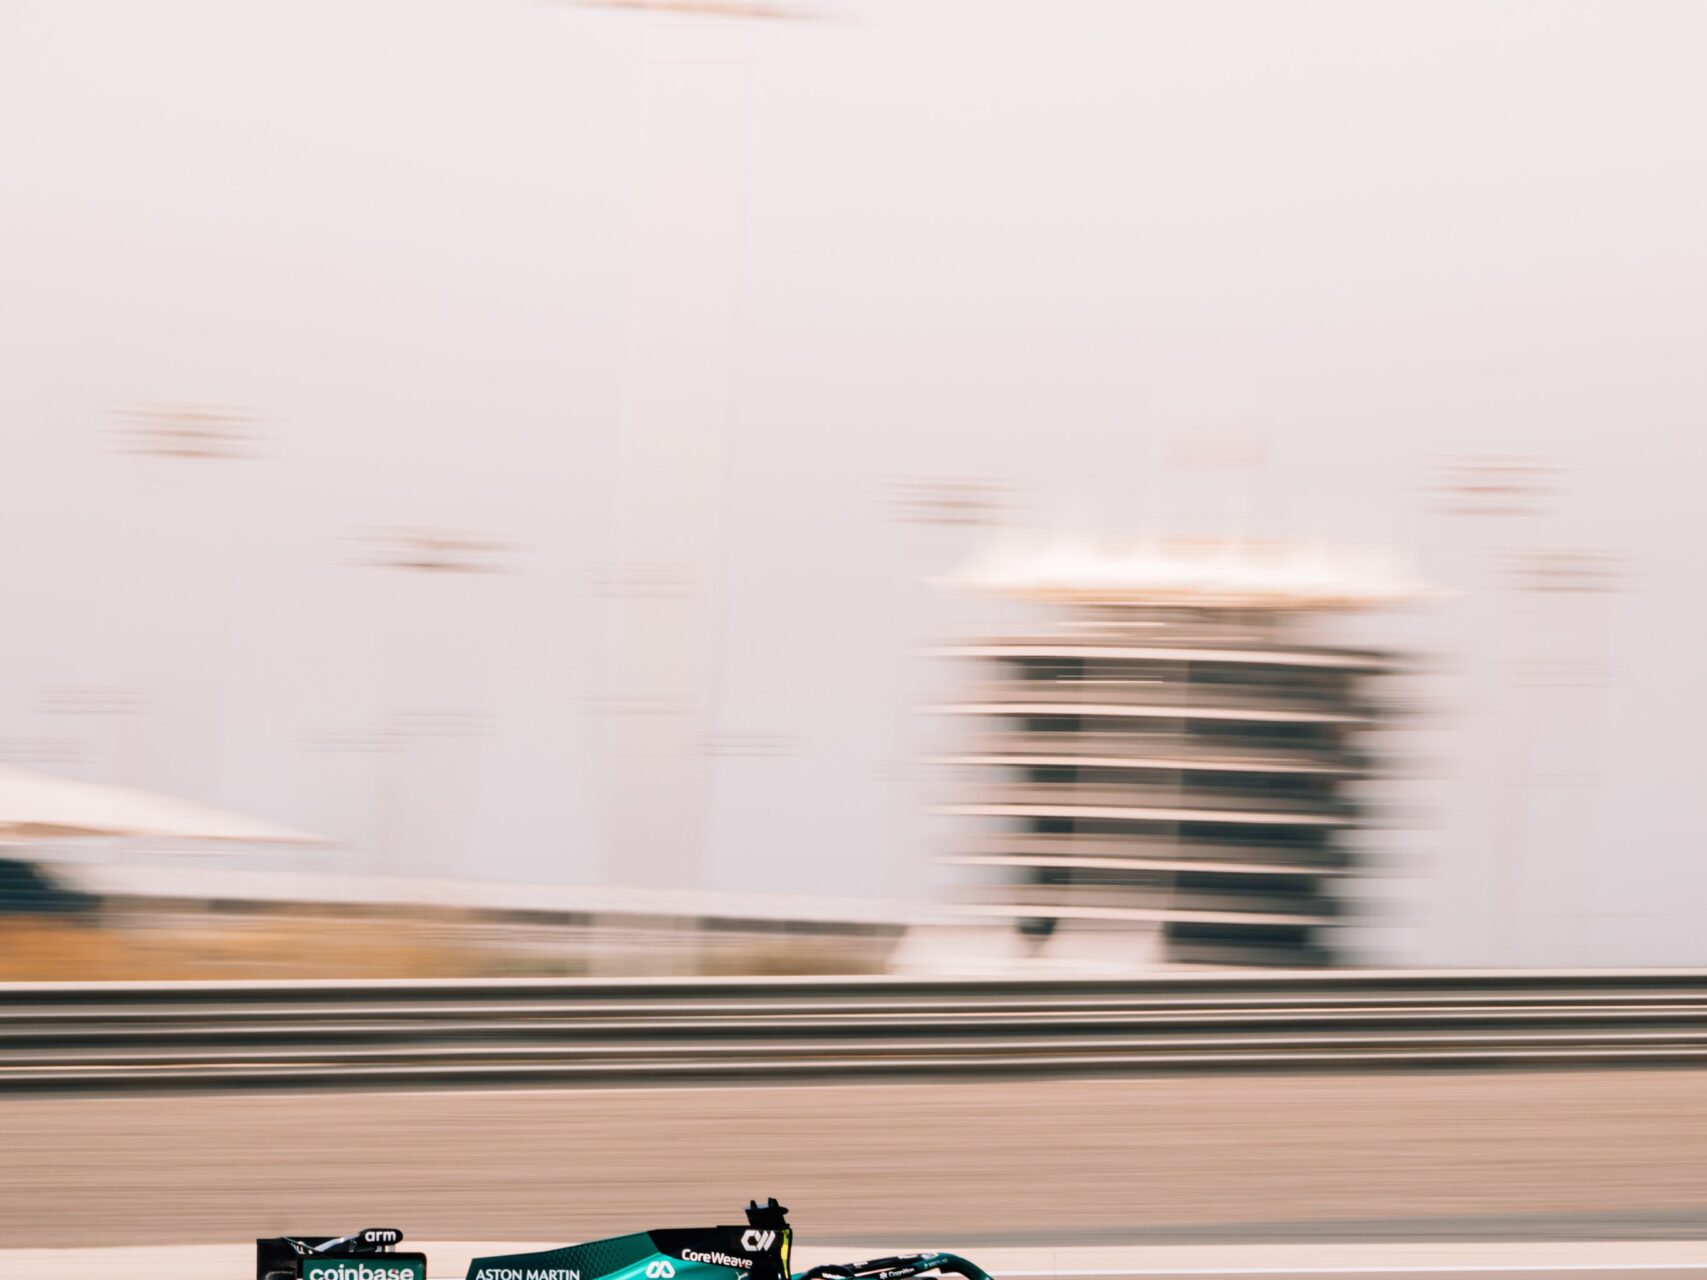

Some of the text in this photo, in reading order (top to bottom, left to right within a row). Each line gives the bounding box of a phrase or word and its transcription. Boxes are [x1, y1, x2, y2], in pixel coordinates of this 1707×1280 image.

[365, 1230, 396, 1242] arm
[681, 1248, 753, 1269] CoreWeave
[475, 1268, 522, 1280] ASTON
